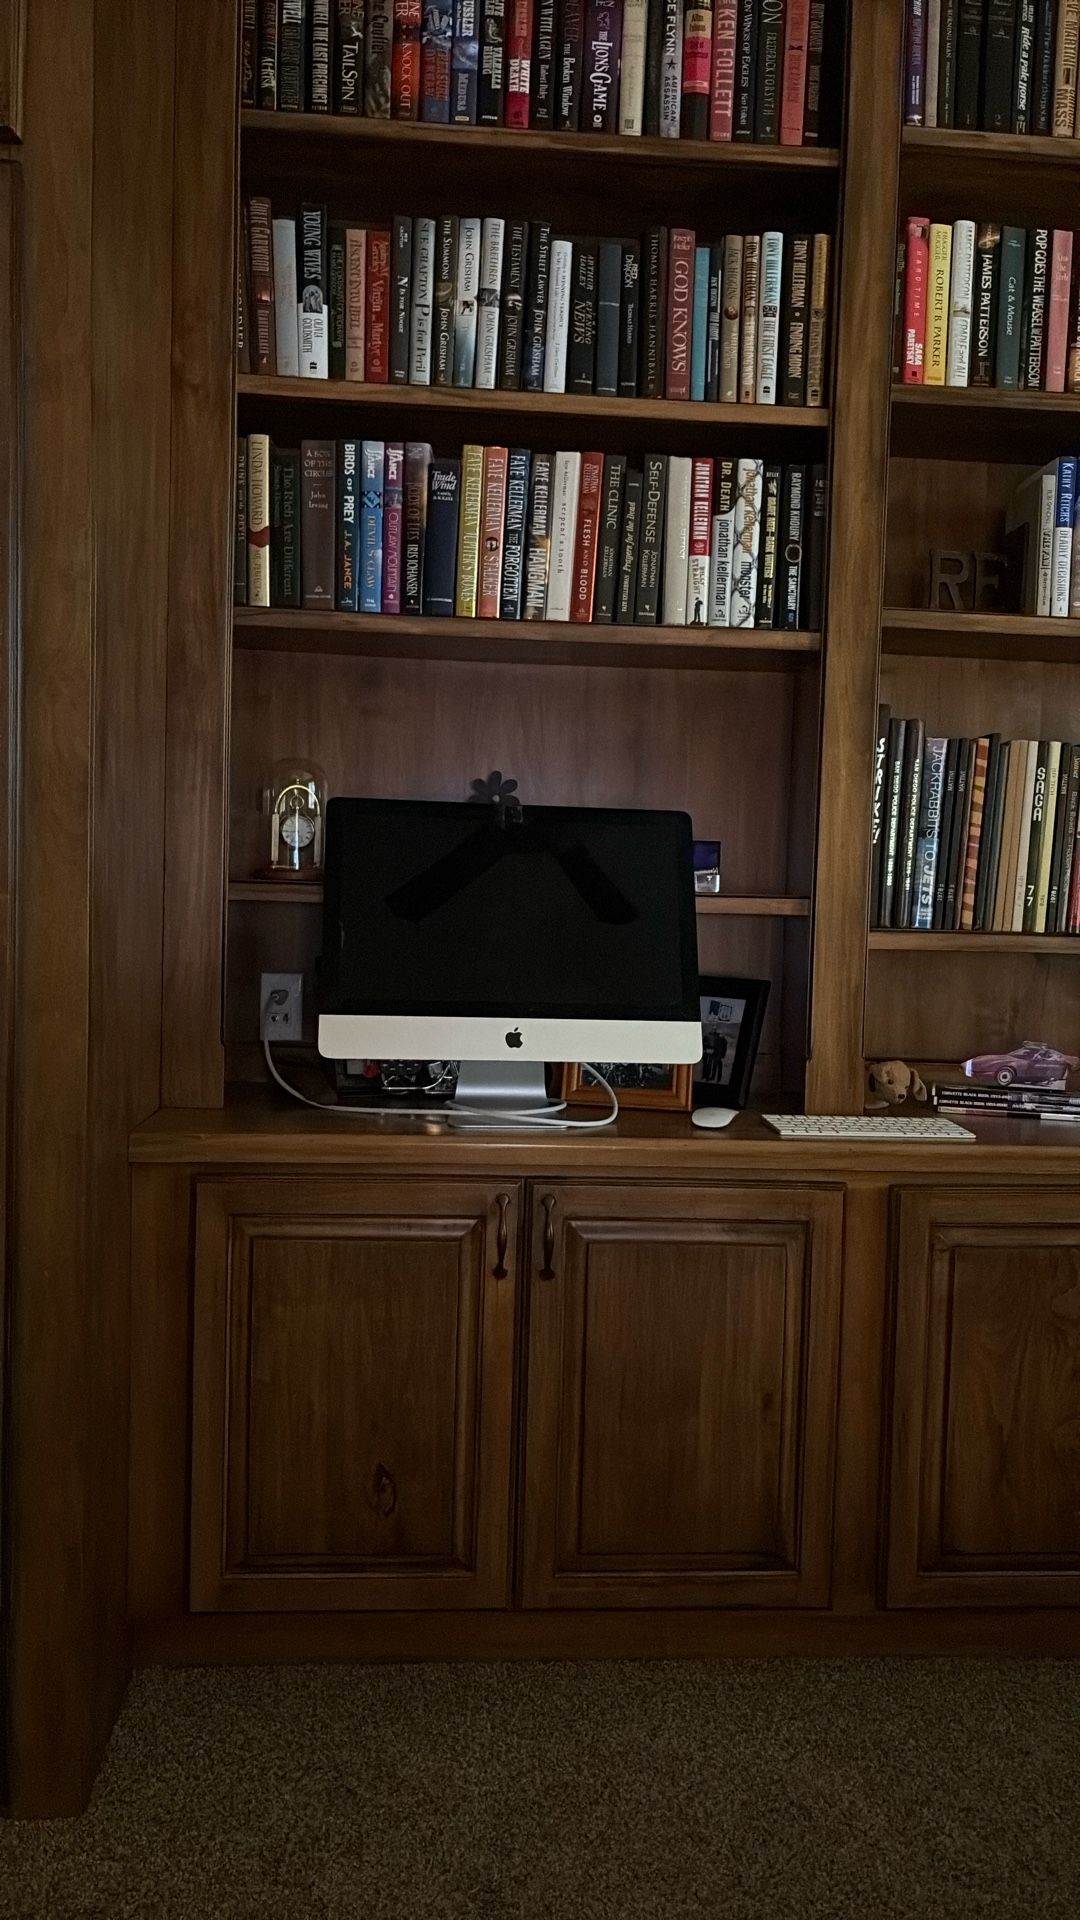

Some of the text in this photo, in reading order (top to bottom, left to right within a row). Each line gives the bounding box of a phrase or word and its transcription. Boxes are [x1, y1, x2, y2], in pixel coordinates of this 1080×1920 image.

[538, 8, 553, 60] WITH GUN
[666, 16, 676, 56] FLYNN
[714, 8, 735, 118] KEN FOLLETT
[740, 14, 752, 87] WINGS EAGLES
[1021, 26, 1032, 58] Ride a
[1062, 20, 1078, 68] MARTINI
[400, 43, 412, 109] KNOCK OUT
[491, 46, 503, 90] VALHALLA
[508, 59, 520, 92] DEATH
[520, 60, 530, 94] WHITE
[562, 58, 576, 116] Broken Window
[590, 72, 612, 111] GAME
[763, 32, 777, 116] FREDERICK FORSYTH
[1056, 88, 1068, 128] MASS
[250, 200, 270, 272] JULIE GARWOOD
[303, 210, 322, 280] YOUNG WIVES
[418, 222, 430, 300] SUE GRAFTON
[442, 220, 452, 280] THE SUMMONS
[464, 228, 474, 292] JOHN GRISHAM
[489, 222, 500, 284] THE BRETHREN
[510, 226, 522, 288] THE TESTAMENT
[536, 227, 550, 304] THE STREET LAWYER
[397, 276, 408, 286] N
[586, 254, 594, 290] ARTHUR
[624, 255, 634, 288] DRAGON
[764, 238, 780, 304] TONY HILLERMAN
[792, 240, 808, 308] TONY HILLERMAN
[914, 250, 922, 282] HARD
[574, 300, 585, 344] NEWS
[584, 300, 594, 344] EVENING
[648, 234, 658, 380] THOMAS HARRIS HANNIBAL
[671, 260, 688, 372] GOD KNOWS
[932, 269, 944, 367] ROBERT PARKER
[978, 254, 993, 357] JAMES PATTERSON
[1006, 276, 1016, 336] Cat & Mouse
[1028, 229, 1048, 387] POP GOES THE WEASEL PATTERSON
[414, 304, 430, 373] P is for Peril
[438, 308, 450, 370] JOHN GRISHAM
[484, 310, 496, 374] JOHN GRISHAM
[504, 315, 518, 376] JOHN GRISHAM
[531, 310, 544, 376] JOHN GRISHAM
[760, 334, 774, 380] FIRST EAGLE
[788, 322, 804, 378] FINDING MOON
[906, 329, 916, 366] PARETSKY
[915, 343, 923, 366] SARA
[250, 441, 264, 526] LINDA HOWARD
[343, 444, 355, 524] BIRDS OF PREY
[432, 480, 458, 490] Wind
[464, 452, 481, 526] FAYE KELLERMAN
[606, 464, 621, 530] THE CLINIC
[645, 461, 662, 543] SELF-DEFENSE
[692, 462, 710, 540] JONATHAN KELLERMAN
[720, 462, 732, 512] DR. DEATH
[788, 472, 802, 541] RAYMOND KHOURY
[1060, 462, 1074, 522] KATHY REICHS
[482, 457, 504, 596] FAYE KELLERMAN STALKER
[502, 456, 526, 601] FAYE KELLERMAN FORGOTTEN
[526, 462, 550, 607] FAYE KELLERMAN HANGMAN
[624, 520, 635, 546] for the
[343, 554, 352, 589] JANCE
[406, 544, 418, 596] IRIS JOHANSEN
[579, 519, 592, 600] FLESH AND BLOOD
[602, 546, 610, 578] KELLERMAN
[640, 550, 650, 588] KELLERMAN
[648, 550, 658, 588] JONATHAN
[692, 558, 700, 594] STRAIGHT
[715, 518, 732, 606] jonathan kellerman
[740, 561, 752, 600] monster
[787, 566, 798, 610] THE SANCTUARY
[1056, 560, 1068, 602] DECISIONS
[892, 775, 900, 794] DIEGO
[926, 746, 942, 838] JACKRABBITS
[1032, 767, 1046, 822] SAGA
[888, 818, 897, 857] DEPARTMENT
[908, 818, 916, 858] DEPARTMENT
[924, 844, 938, 862] TO
[921, 865, 933, 906] JETS
[1026, 884, 1035, 907] 77
